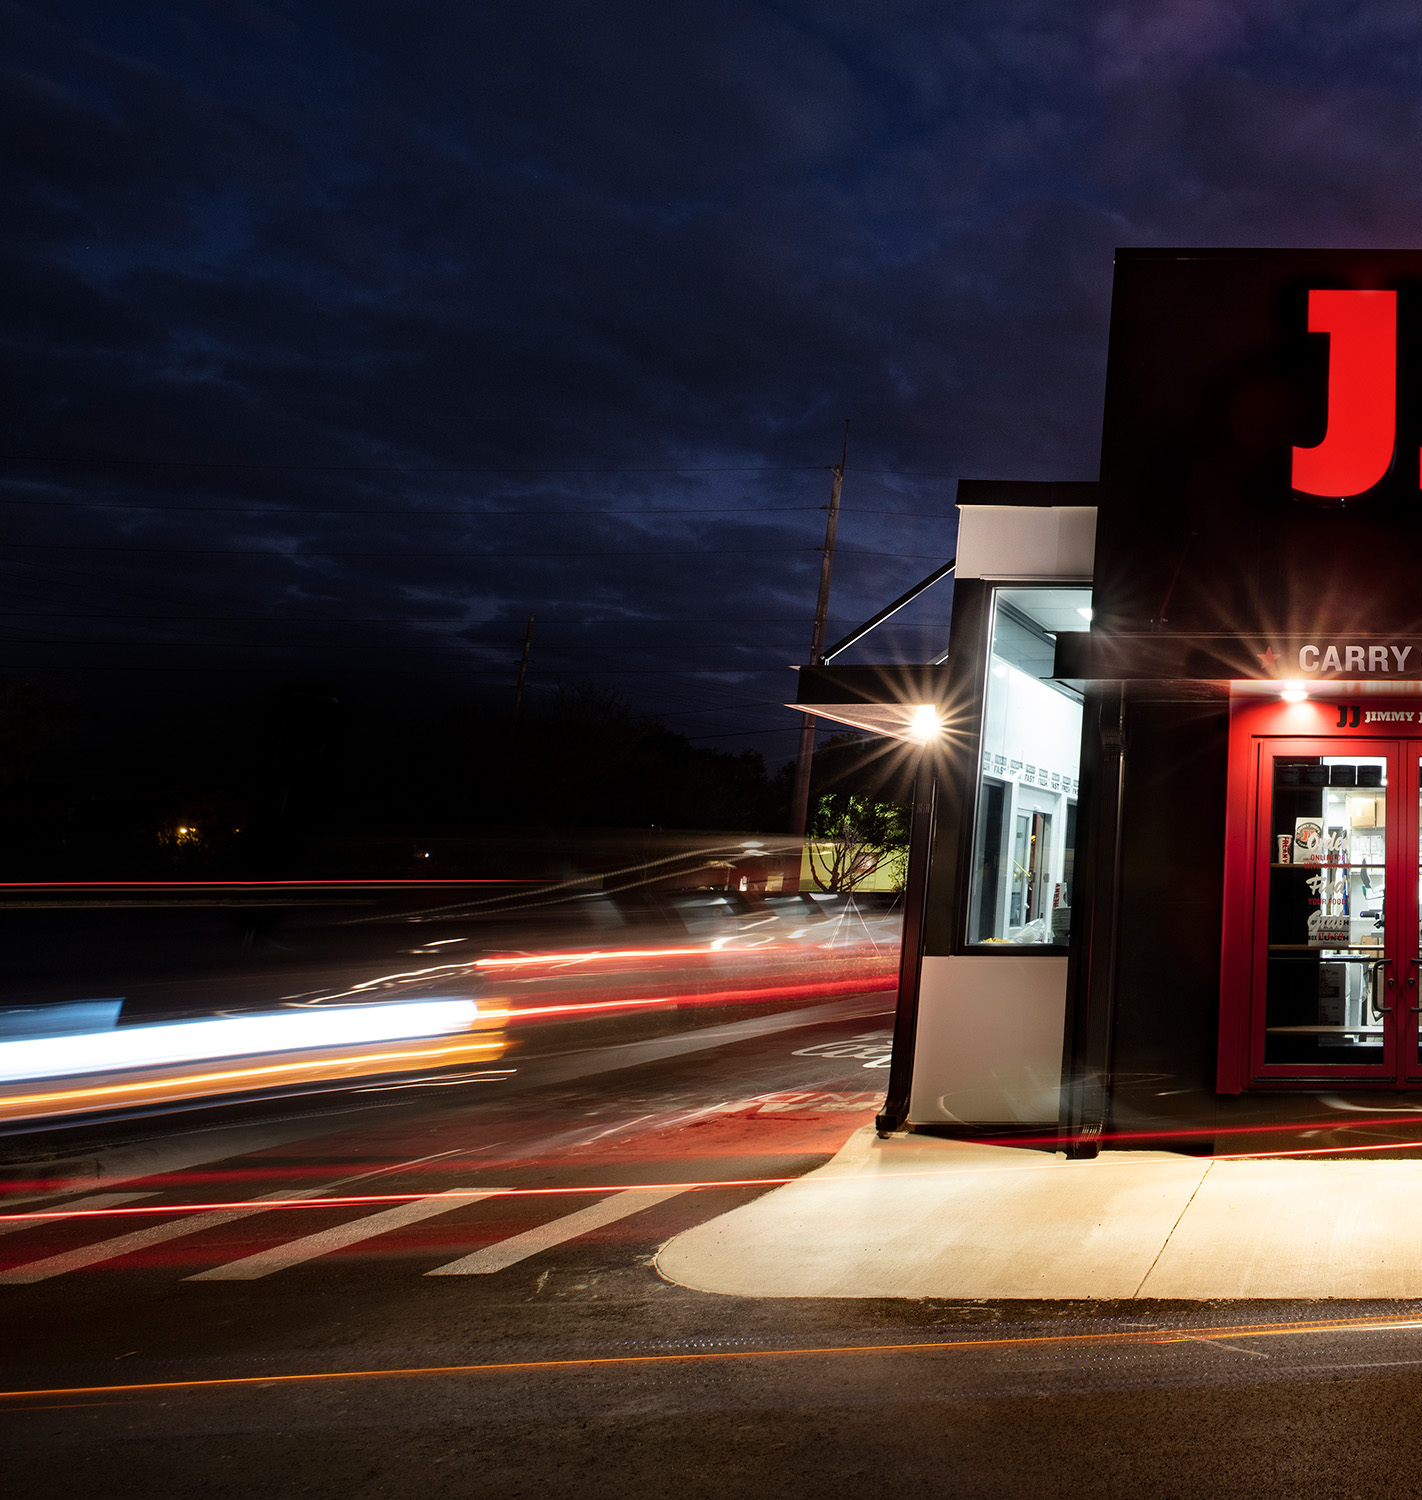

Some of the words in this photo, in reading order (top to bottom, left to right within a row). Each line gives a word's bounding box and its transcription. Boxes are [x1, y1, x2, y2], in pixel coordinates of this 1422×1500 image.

[1299, 645, 1412, 672] CARRY
[1336, 705, 1360, 728] JJ
[1364, 711, 1414, 723] JIMMY
[1306, 874, 1347, 895] Find
